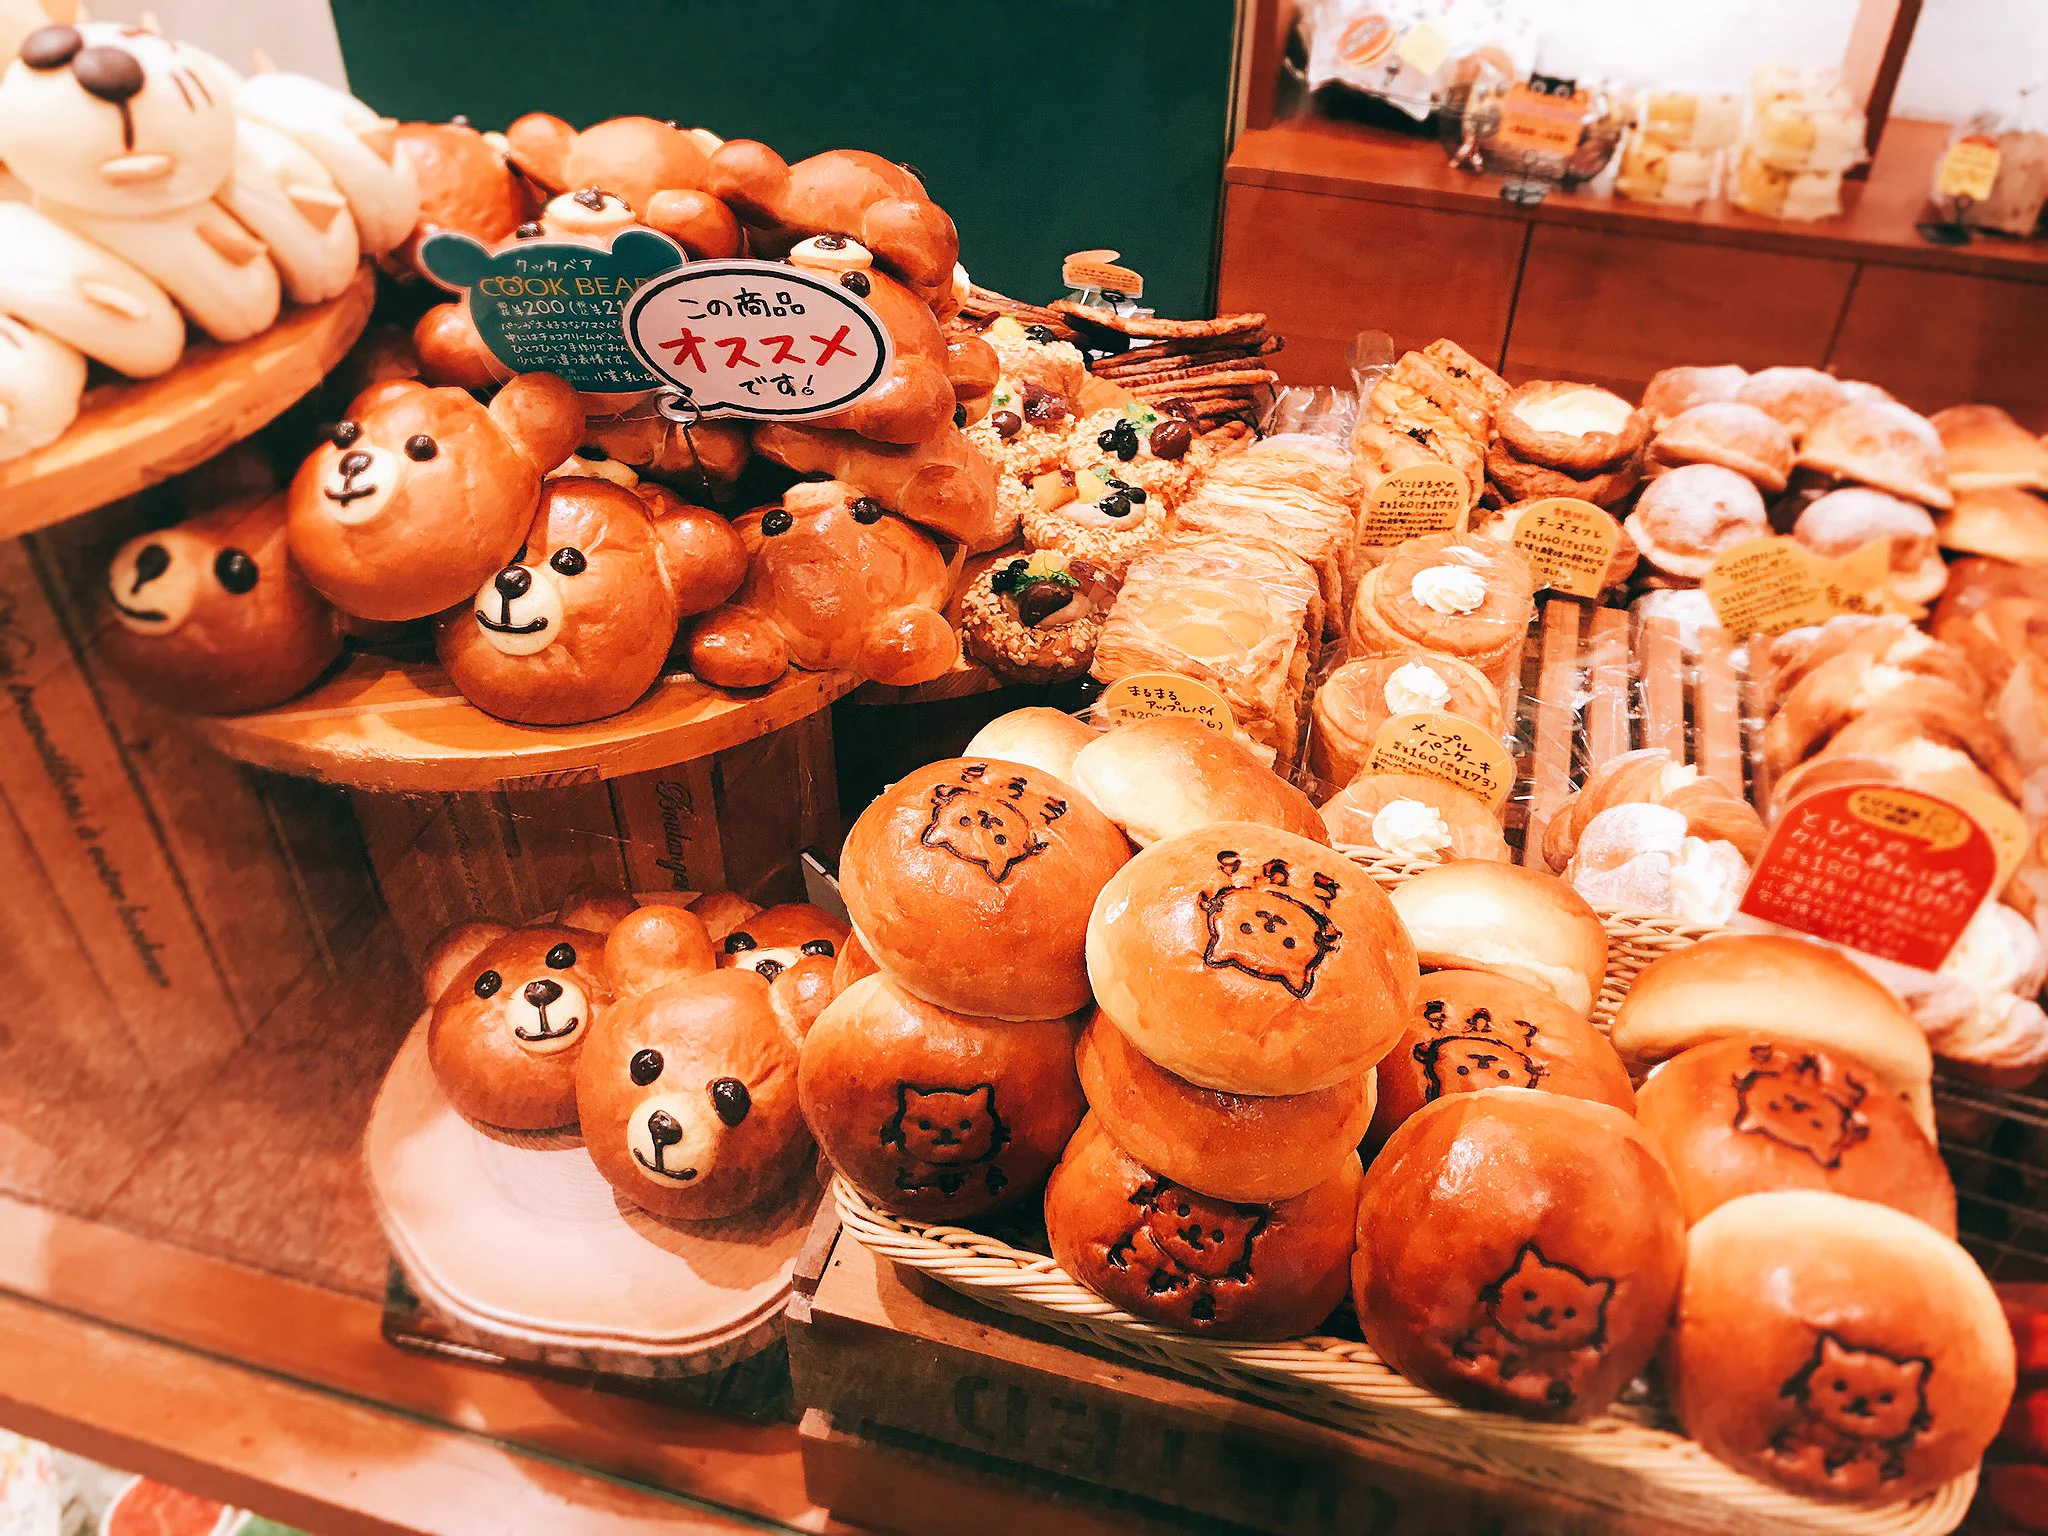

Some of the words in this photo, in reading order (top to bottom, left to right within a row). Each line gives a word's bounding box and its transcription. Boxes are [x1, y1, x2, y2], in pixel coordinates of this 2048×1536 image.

[516, 258, 593, 272] クックベア
[479, 275, 570, 297] COOK
[678, 286, 806, 320] この商品
[658, 324, 858, 374] オススメ
[1385, 479, 1455, 489] べにはるかの
[1398, 488, 1460, 499] スイートポテト
[1537, 516, 1602, 539] チーズスフレ
[1127, 685, 1178, 701] まるまる
[1145, 700, 1215, 717] アップルパイ
[1411, 723, 1473, 752] メープル
[1420, 739, 1491, 775] パンケーキ
[1791, 828, 1976, 897] クリームあんぱん
